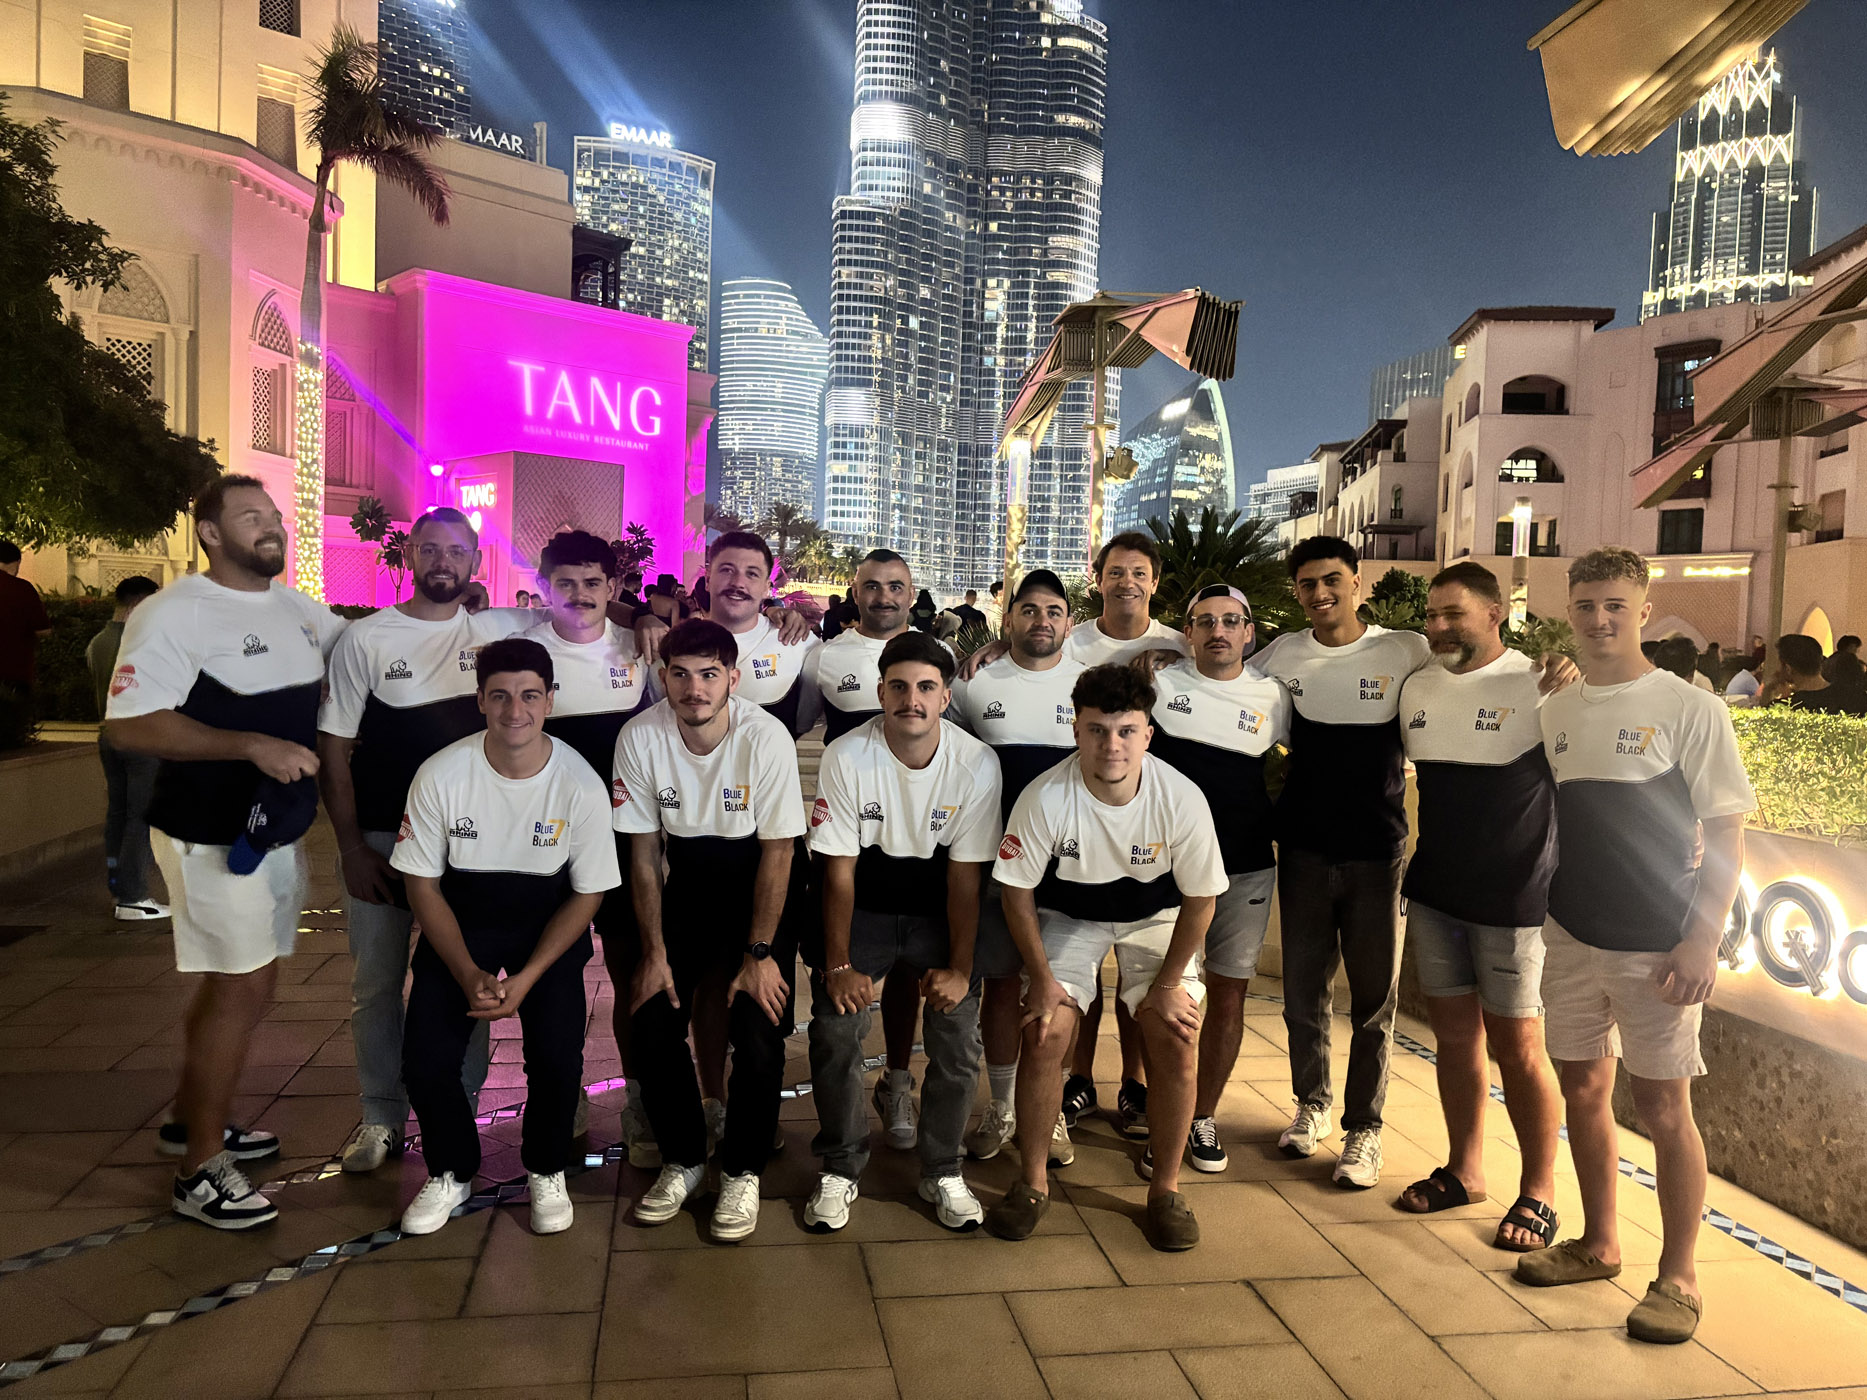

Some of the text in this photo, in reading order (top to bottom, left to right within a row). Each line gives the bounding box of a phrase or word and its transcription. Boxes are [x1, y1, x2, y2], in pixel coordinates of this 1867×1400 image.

[610, 122, 673, 148] EMAAR
[507, 359, 662, 436] TANG
[556, 429, 591, 443] LUXURY
[594, 436, 650, 451] RESTAURANT
[460, 482, 496, 508] TANG
[459, 662, 478, 672] BLA
[534, 821, 554, 834] BLUE
[532, 834, 559, 847] BLACK
[1131, 844, 1153, 856] BLUE
[1130, 856, 1157, 866] BLACK
